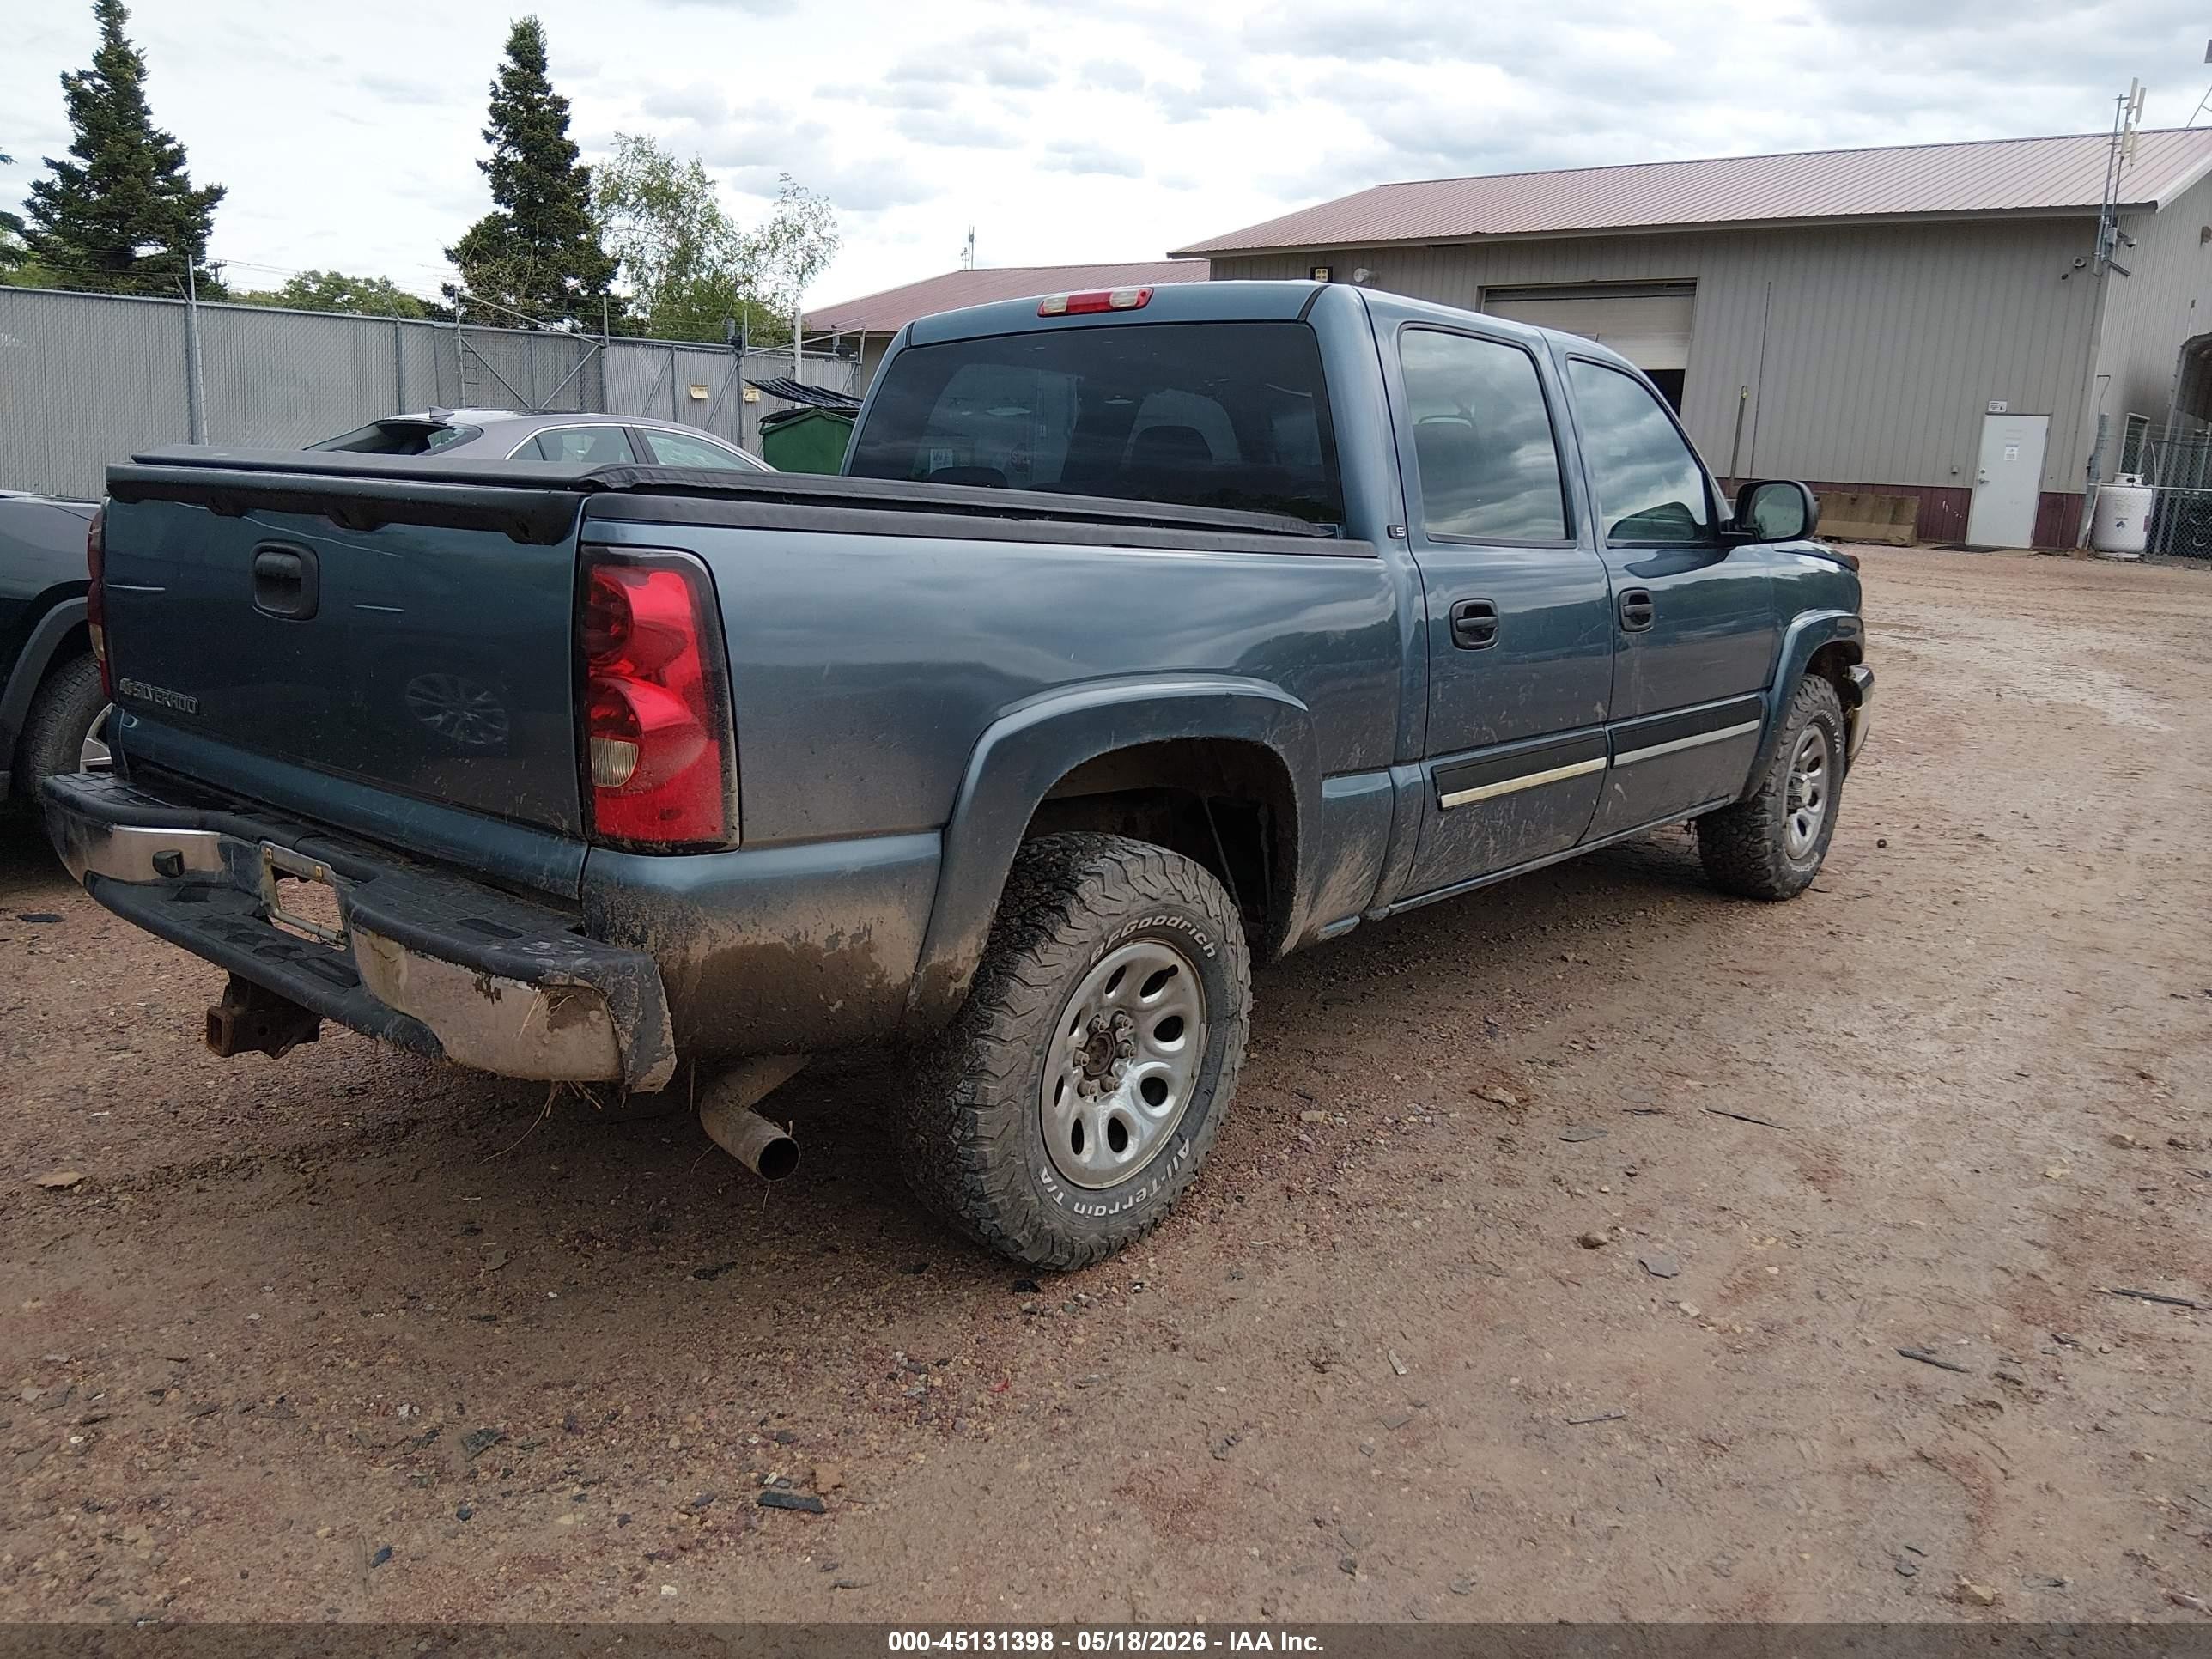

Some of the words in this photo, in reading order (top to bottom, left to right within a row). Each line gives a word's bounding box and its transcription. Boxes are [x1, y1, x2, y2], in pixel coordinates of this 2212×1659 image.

[1090, 915, 1216, 966] BFGoodrich
[1039, 1166, 1065, 1206] T/A
[1073, 1136, 1190, 1219] All-Terrain
